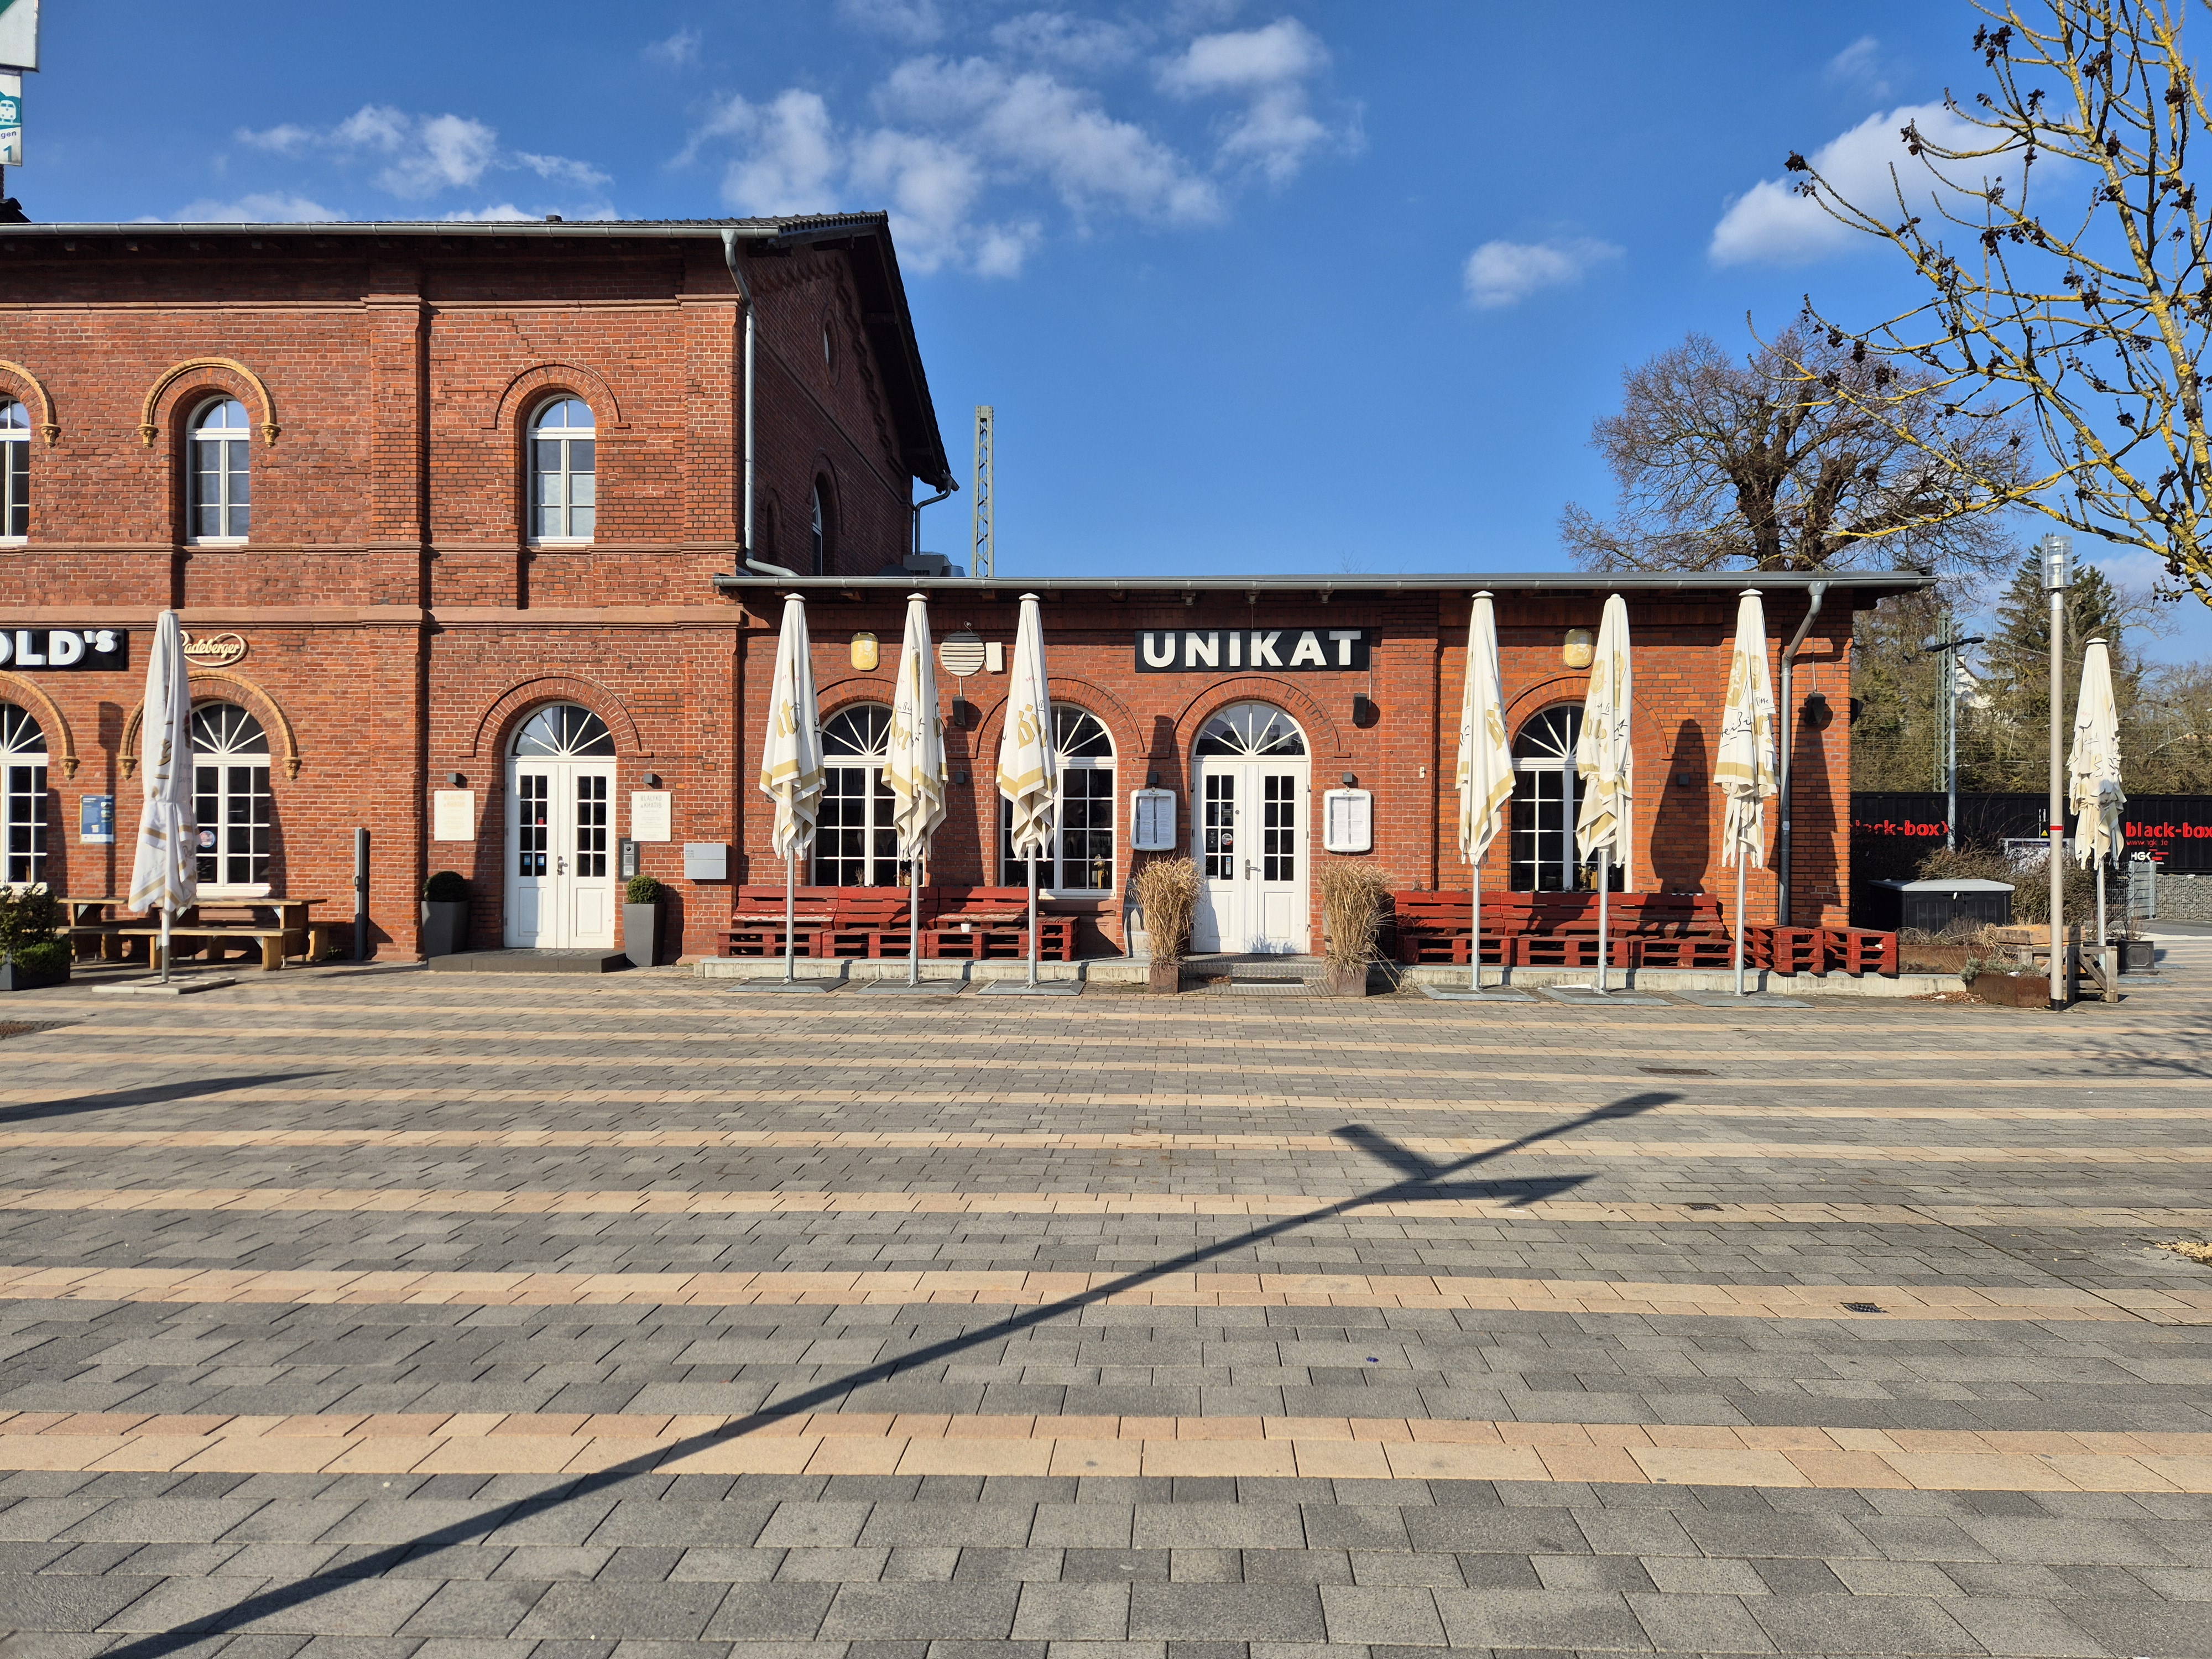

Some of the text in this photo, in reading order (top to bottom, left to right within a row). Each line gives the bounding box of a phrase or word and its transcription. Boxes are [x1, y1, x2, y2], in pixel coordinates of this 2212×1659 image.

[180, 630, 240, 659] adeberger
[1143, 630, 1361, 667] UNIKAT
[2131, 852, 2152, 860] HGK
